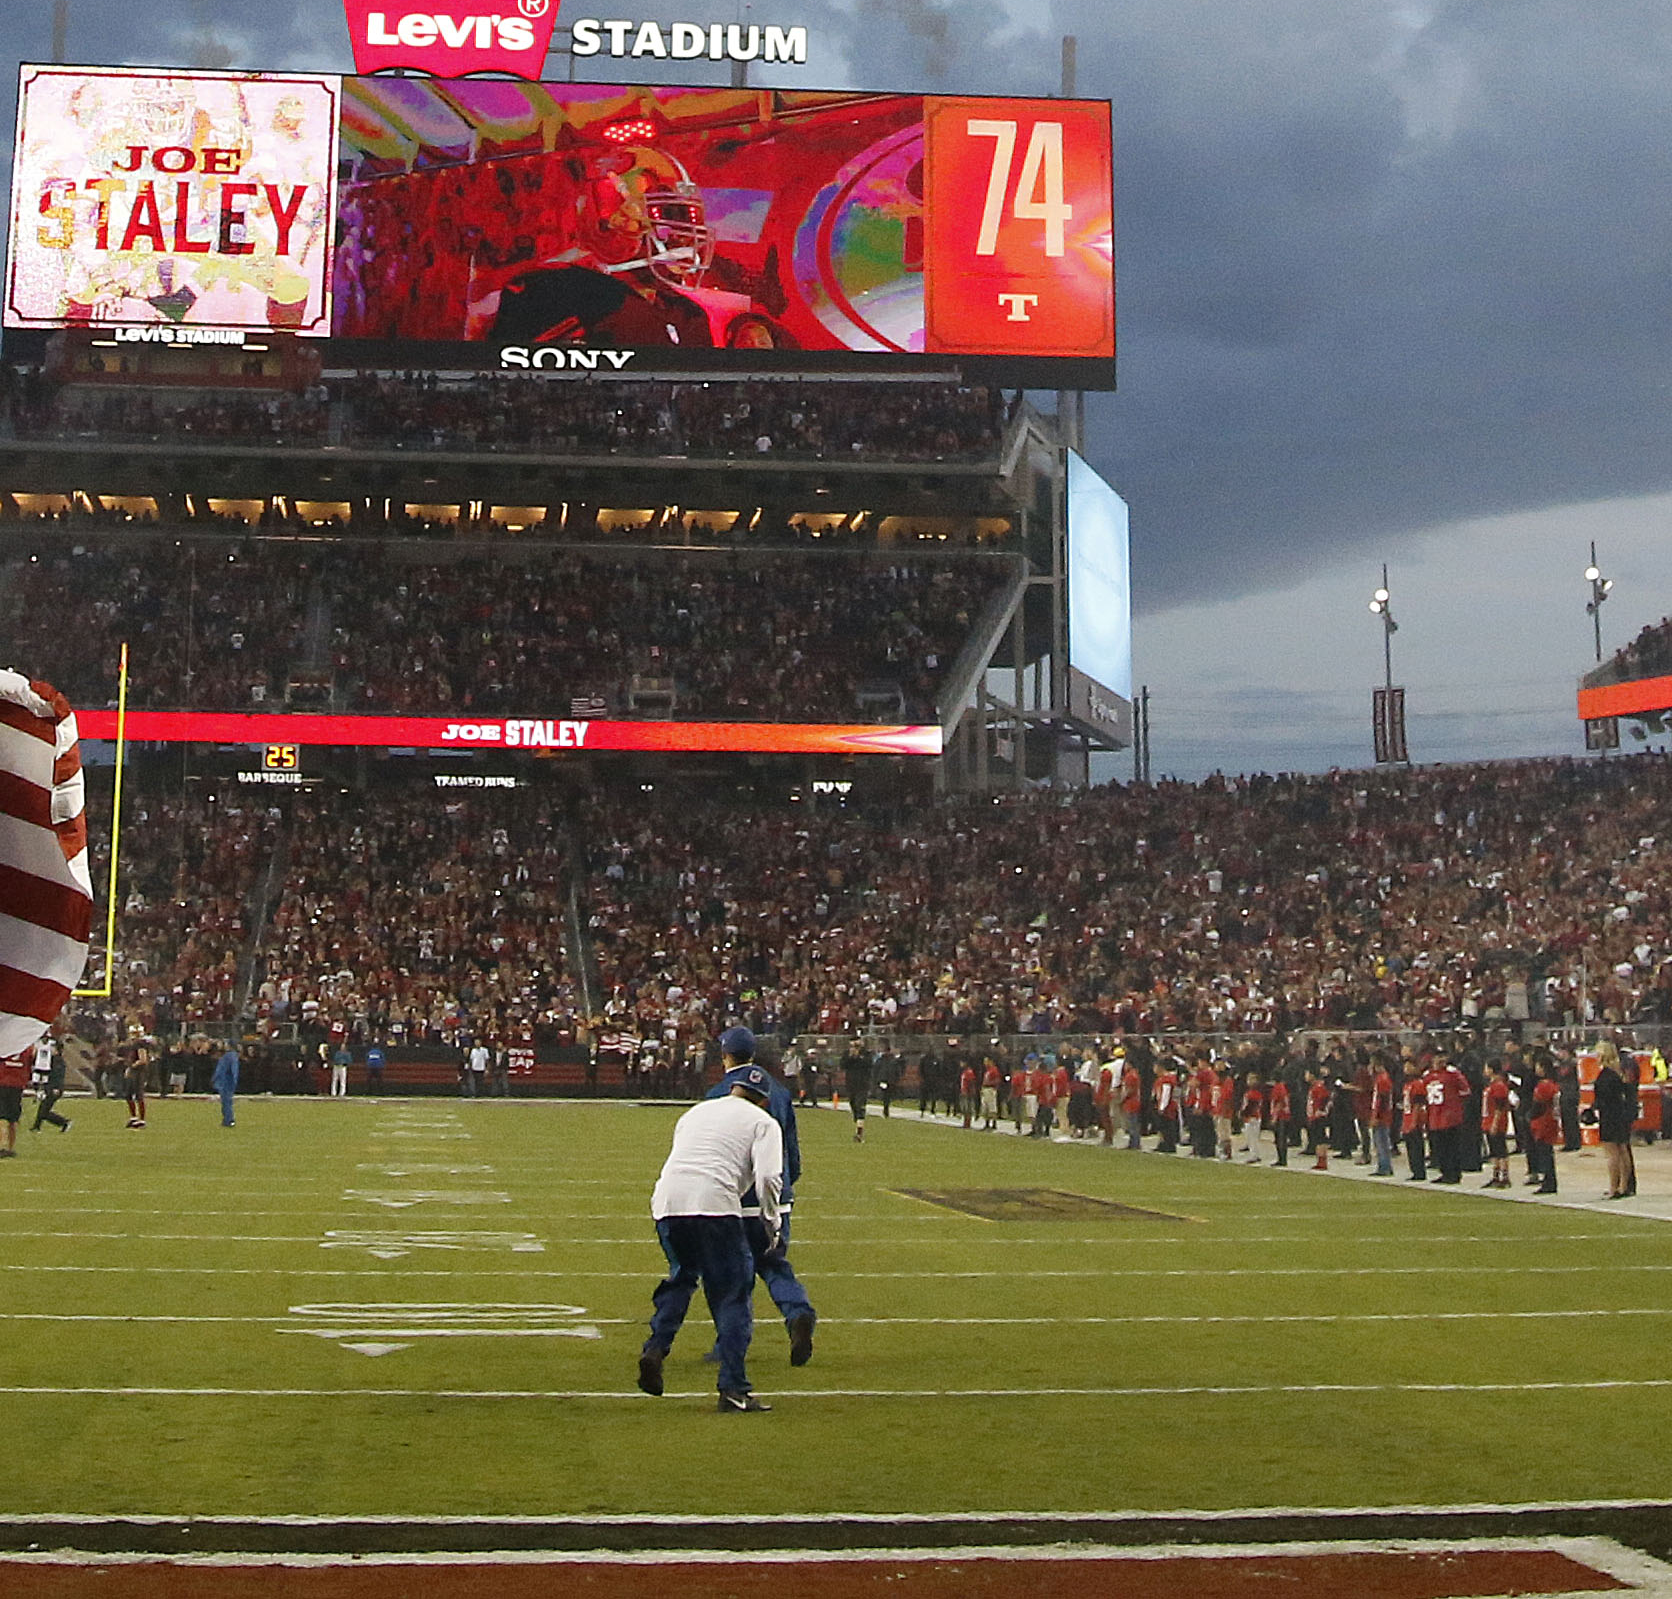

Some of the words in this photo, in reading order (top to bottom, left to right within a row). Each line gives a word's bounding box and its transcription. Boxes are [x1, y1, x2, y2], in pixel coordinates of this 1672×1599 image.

[571, 19, 807, 62] STADIUM
[112, 145, 242, 175] JOE
[967, 119, 1072, 257] 74
[36, 177, 309, 256] STALEY
[998, 293, 1038, 321] T
[175, 331, 245, 345] STADIUM
[500, 347, 636, 369] SONY
[441, 724, 501, 740] JOE
[505, 719, 589, 747] STALEY
[265, 745, 296, 768] 25
